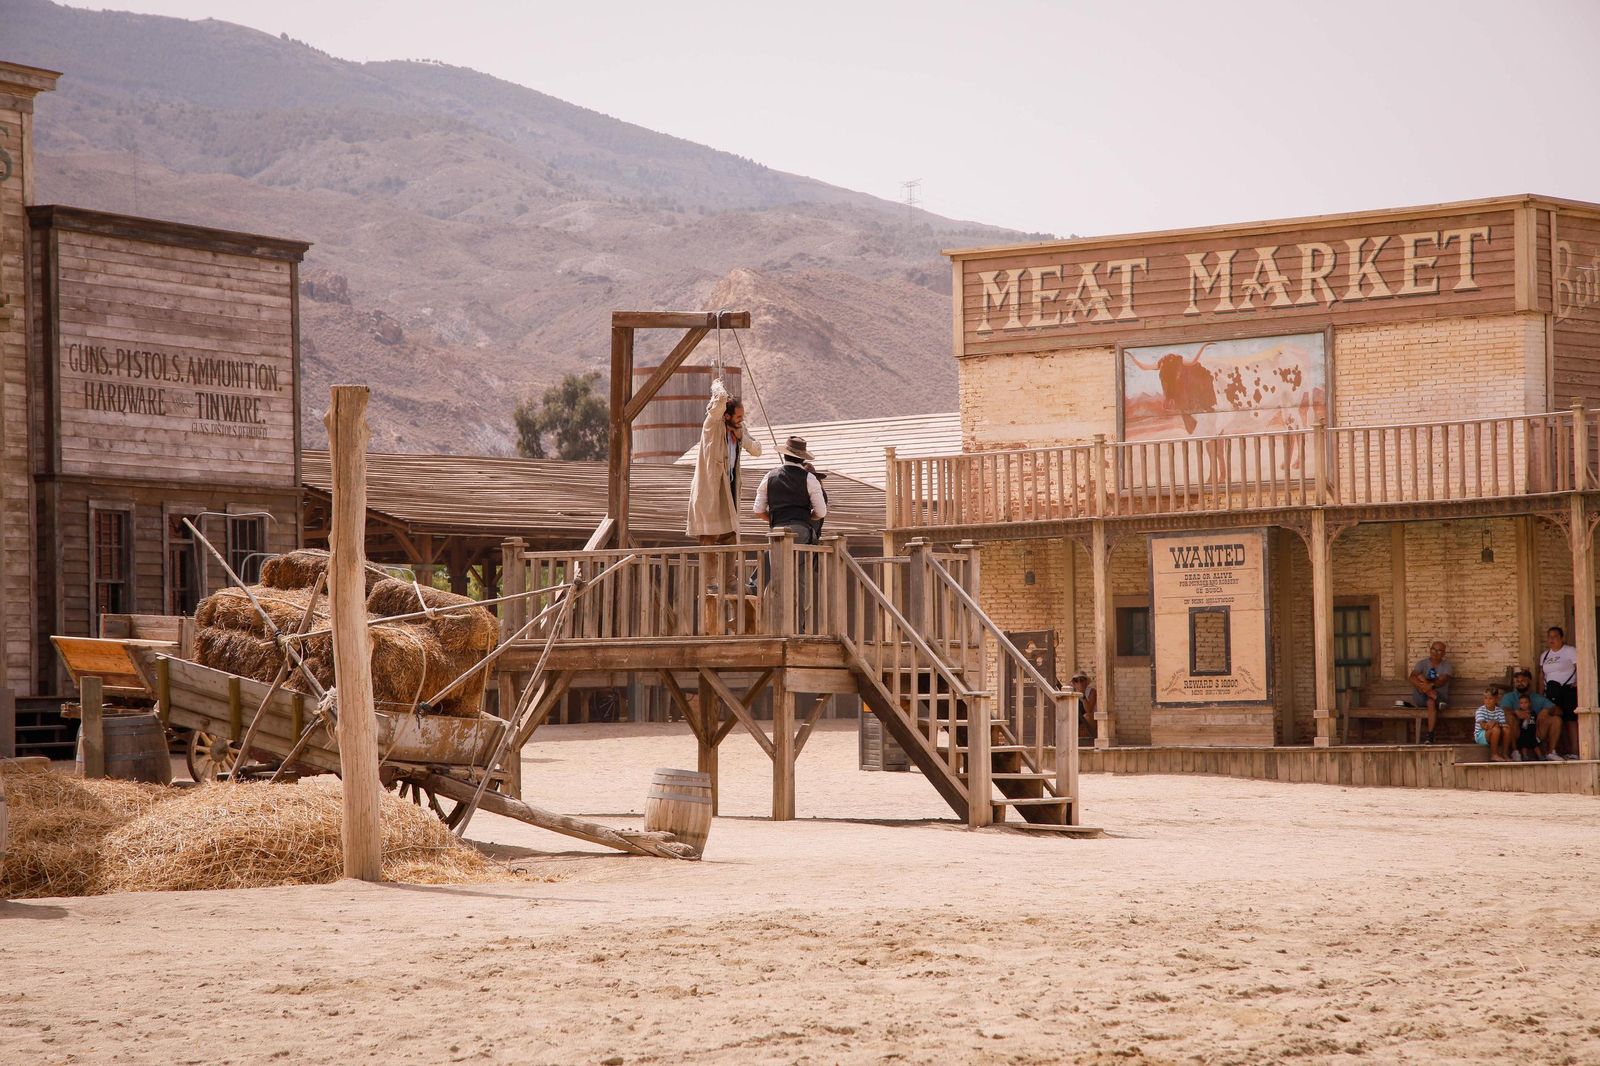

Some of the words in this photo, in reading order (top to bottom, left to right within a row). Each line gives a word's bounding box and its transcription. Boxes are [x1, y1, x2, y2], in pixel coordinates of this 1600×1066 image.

[976, 257, 1149, 335] MEAT
[1183, 225, 1492, 317] MARKET
[69, 343, 113, 376] GUNS.
[116, 348, 184, 383] PISTOLS.
[186, 357, 283, 392] AMMUNITION.
[84, 381, 166, 416] HARDWARE
[195, 391, 266, 425] TINWARE.
[1169, 544, 1245, 569] WANTED
[1183, 680, 1213, 689] REWARD
[1215, 679, 1220, 688] $
